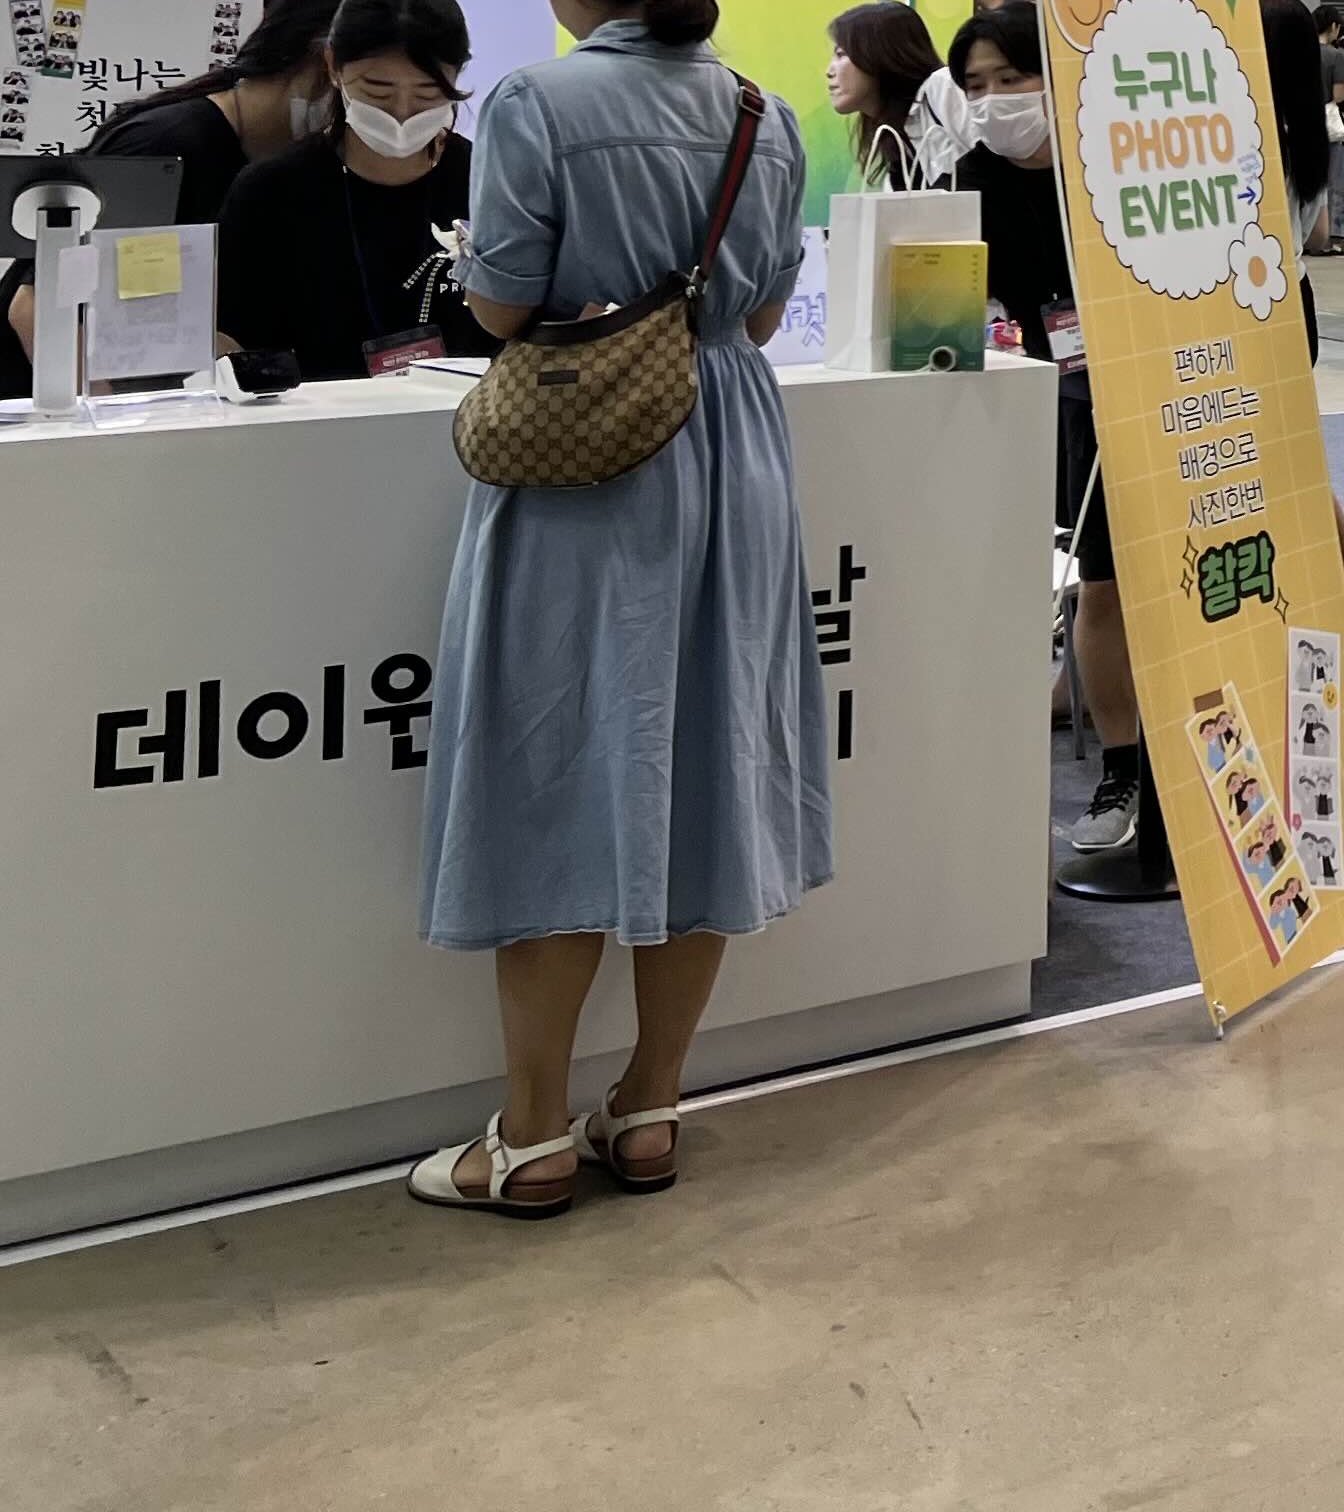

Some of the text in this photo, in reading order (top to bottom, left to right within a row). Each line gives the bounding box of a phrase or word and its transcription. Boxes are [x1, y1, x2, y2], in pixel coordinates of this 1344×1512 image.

[76, 57, 186, 91] 빛나는
[1111, 48, 1218, 111] 누구나
[1108, 112, 1235, 176] PHOTO
[1118, 173, 1239, 239] EVENT
[1173, 338, 1235, 383] 편하게
[1161, 386, 1260, 434] 마음에드는
[1179, 432, 1259, 481] 배경으로
[1187, 478, 1265, 529] 사진한번
[1198, 530, 1275, 623] 찰칵
